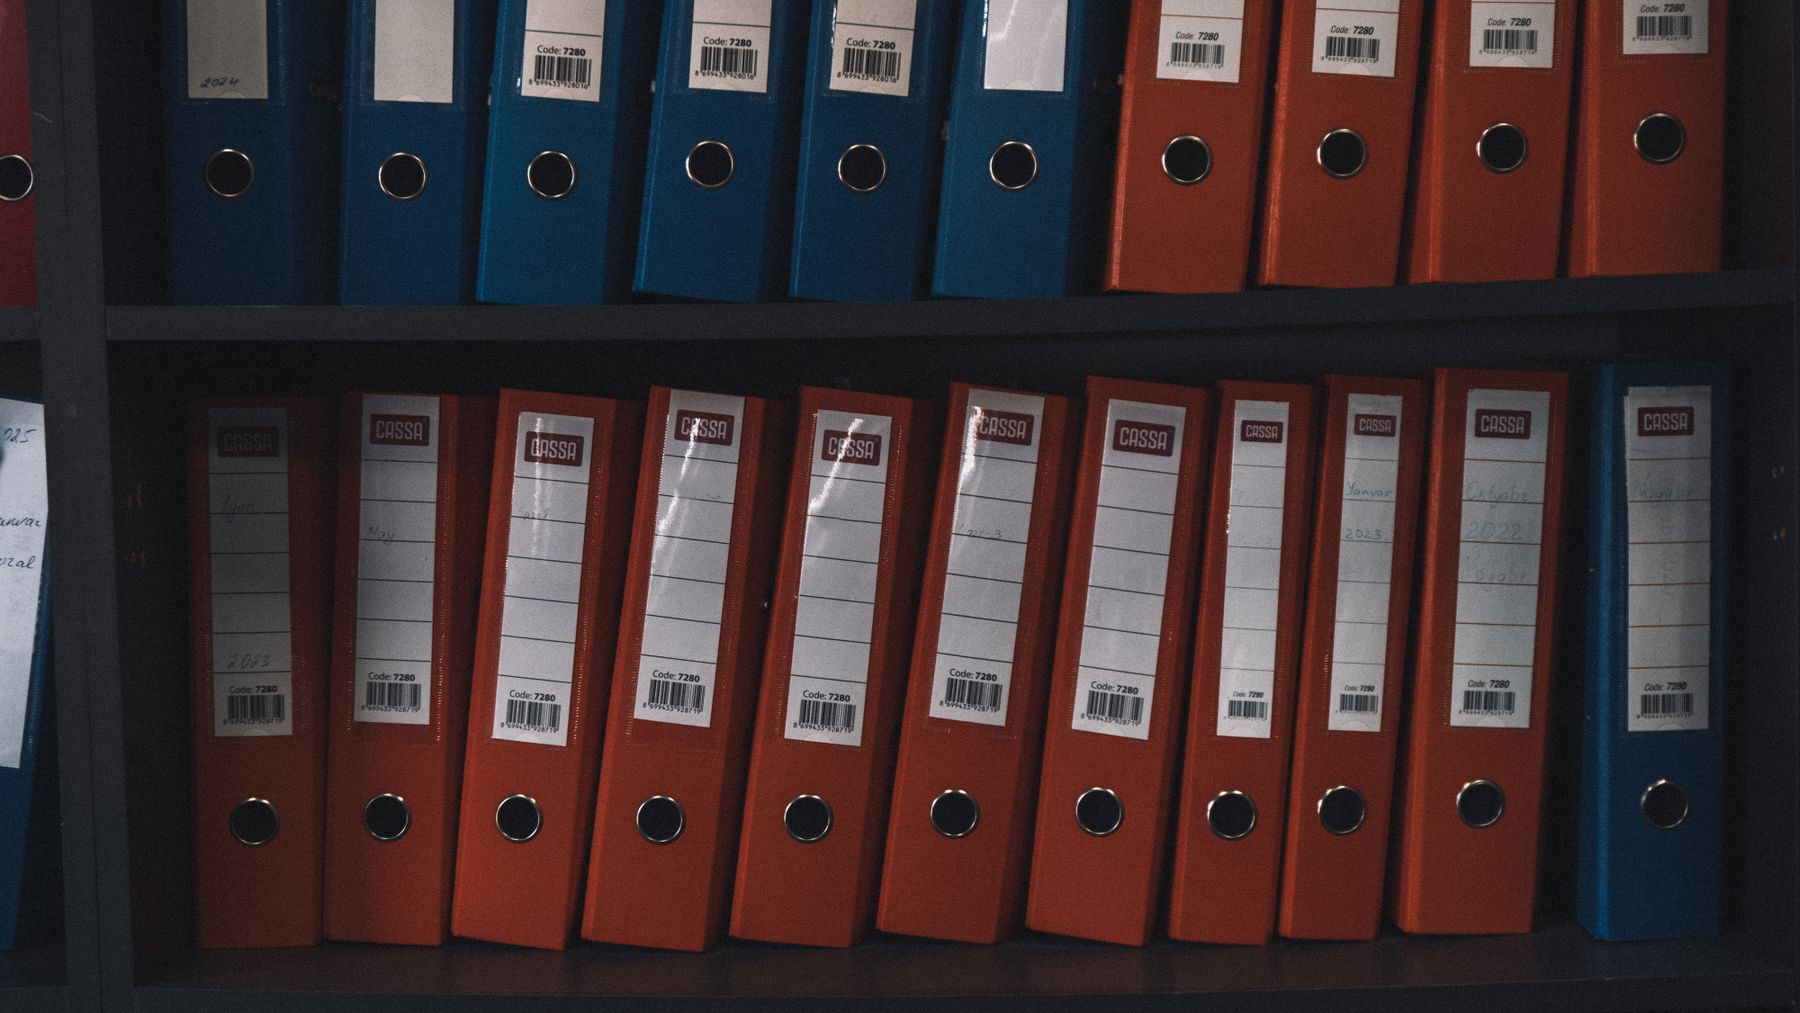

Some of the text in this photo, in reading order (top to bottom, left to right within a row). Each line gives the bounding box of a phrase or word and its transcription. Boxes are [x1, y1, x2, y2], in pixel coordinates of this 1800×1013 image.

[1198, 31, 1220, 41] 7280
[1353, 25, 1375, 35] 7280
[703, 36, 752, 47] Code: 7280
[846, 37, 896, 50] Code: 7280
[536, 45, 586, 57] Code: 7280
[200, 77, 240, 88] 2024
[681, 417, 728, 440] CASSA
[979, 415, 1027, 439] CASSA
[1359, 418, 1391, 433] CASSA
[1481, 415, 1525, 433] CASSA
[1643, 413, 1688, 432] CASSA
[376, 421, 422, 440] CASSA
[1246, 424, 1278, 439] CASSA
[1119, 427, 1168, 450] CASSA
[531, 438, 577, 461] CASSA
[828, 437, 875, 460] CASSA
[1345, 528, 1383, 540] 2023
[368, 671, 416, 682] Code: 7280
[652, 669, 701, 683] Code: 7280
[949, 668, 998, 682] Code: 7280
[255, 685, 278, 694] 7280
[1091, 680, 1139, 695] Code: 7280
[509, 689, 557, 702] Code: 7280
[802, 689, 851, 702] Code: 7280
